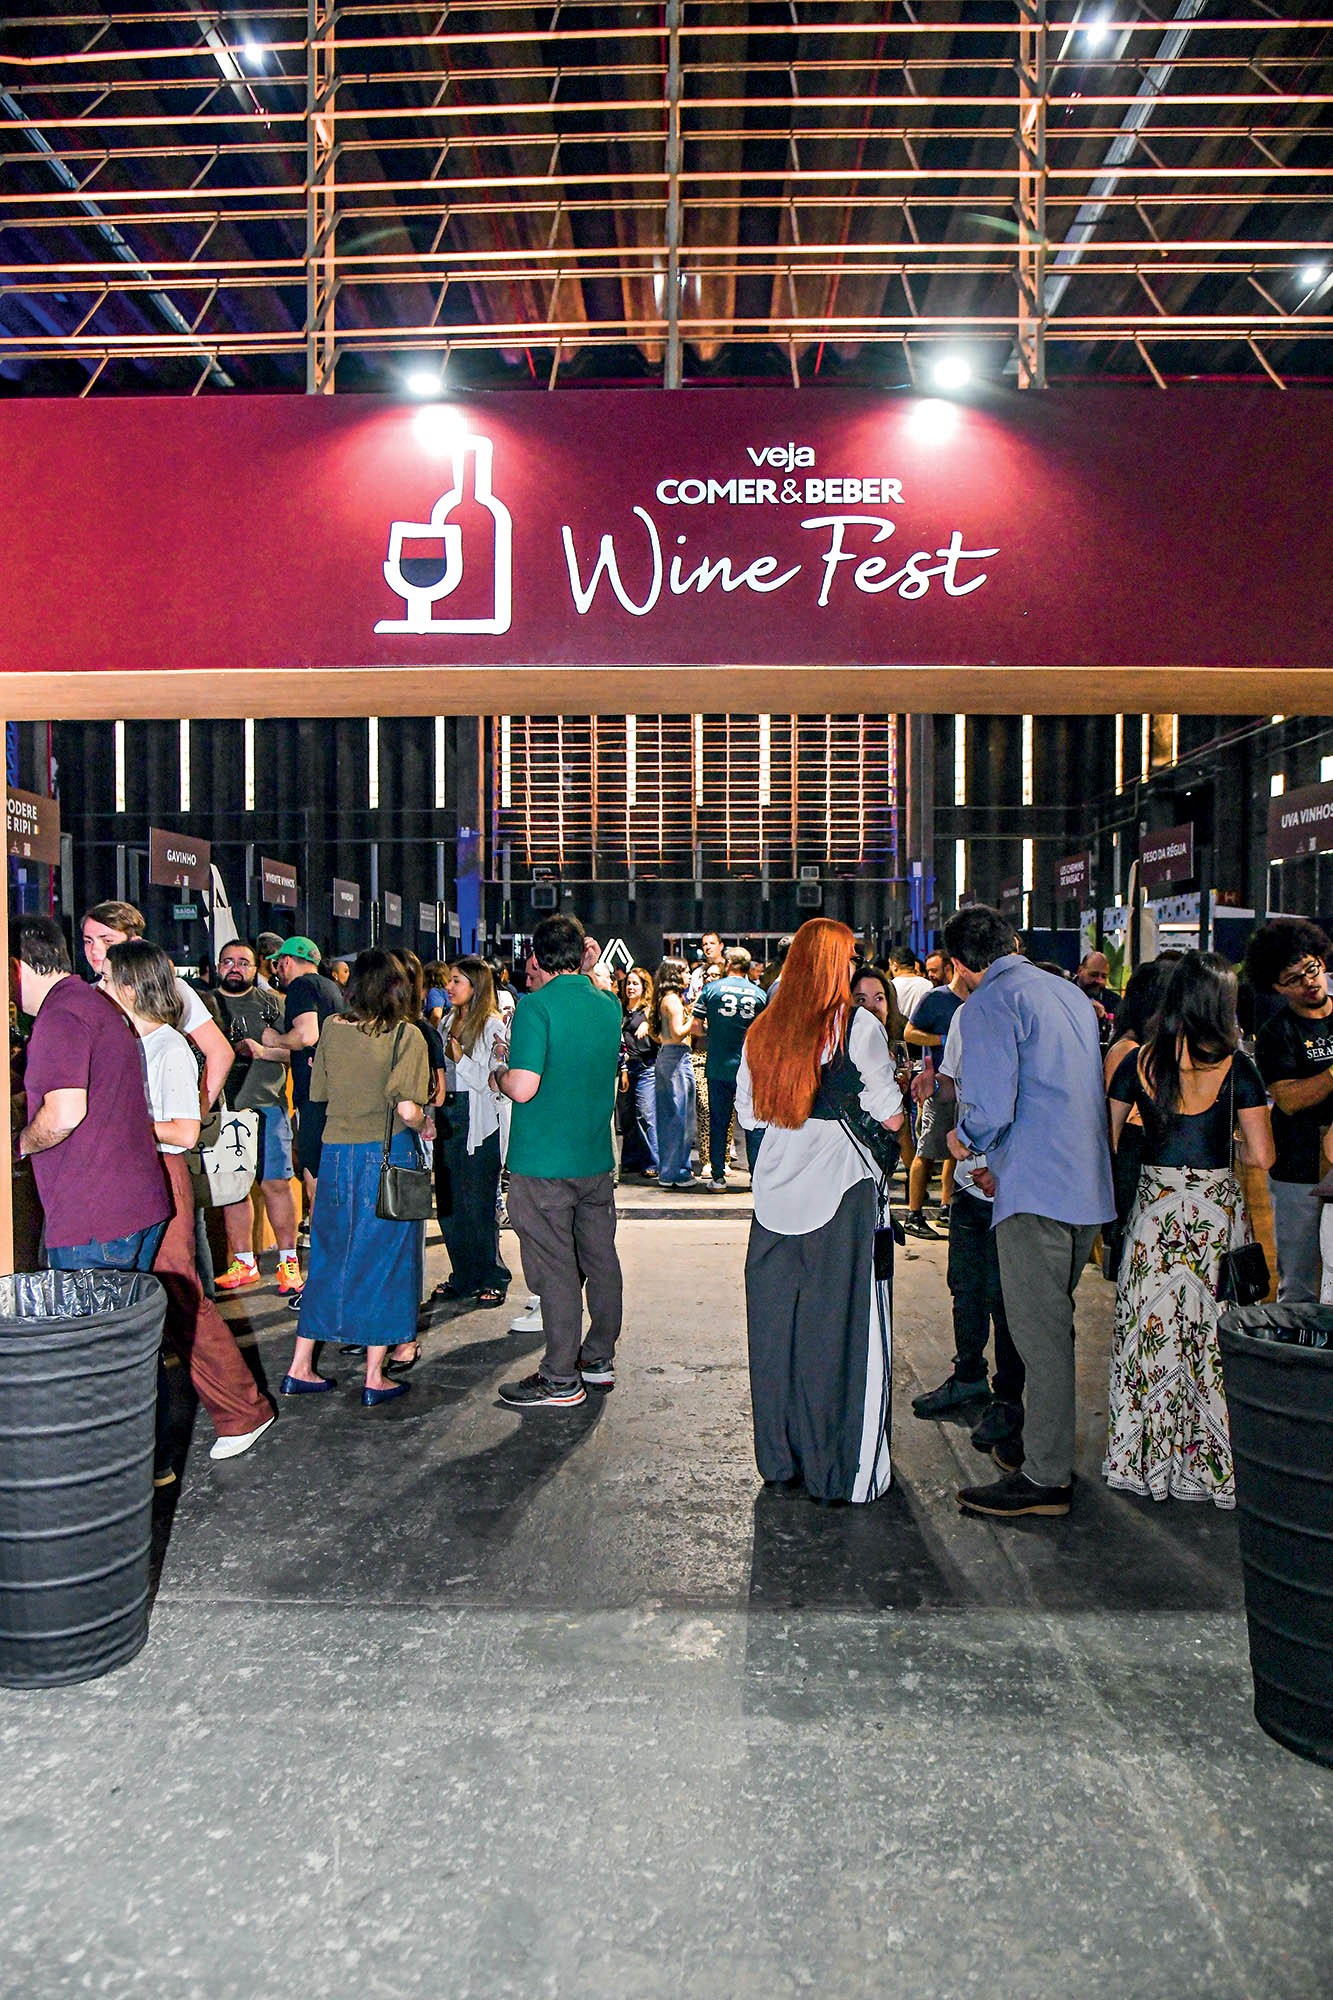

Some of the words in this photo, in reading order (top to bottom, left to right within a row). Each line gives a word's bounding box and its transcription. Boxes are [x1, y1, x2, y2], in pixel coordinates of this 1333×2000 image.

[746, 442, 816, 473] veja
[656, 477, 905, 505] COMER&BEBER
[562, 506, 802, 616] Wine
[800, 515, 1001, 607] Fest
[7, 798, 38, 820] ODERE
[13, 817, 31, 835] RIPI
[1281, 812, 1299, 828] UVA
[166, 849, 197, 866] GAVINHO
[1143, 850, 1157, 863] PESO
[1158, 848, 1165, 860] DA
[1166, 842, 1187, 857] RÉGUA
[718, 993, 756, 1019] 33
[1306, 1047, 1326, 1059] SER
[1326, 1045, 1333, 1056] A
